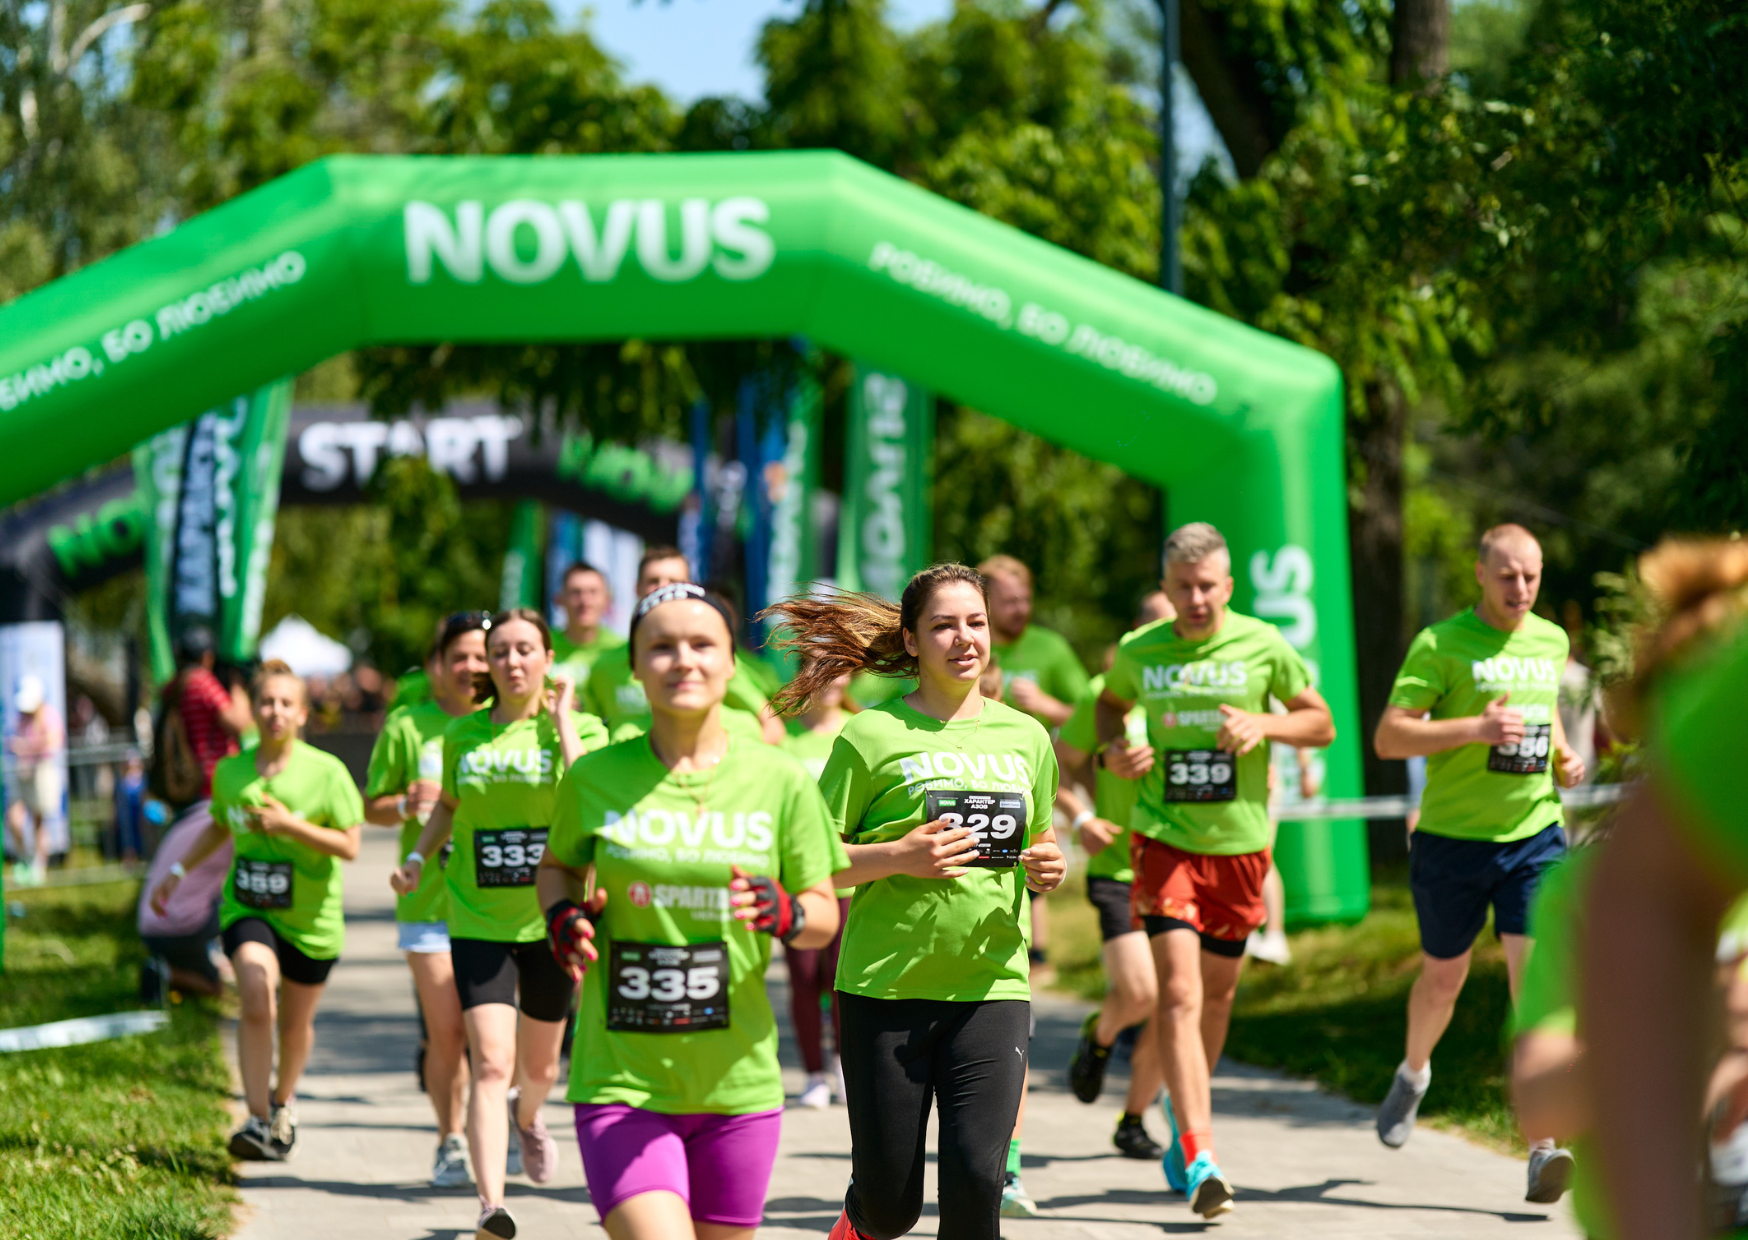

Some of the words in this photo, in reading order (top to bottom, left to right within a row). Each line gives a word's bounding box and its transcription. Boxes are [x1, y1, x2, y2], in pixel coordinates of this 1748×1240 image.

[404, 197, 775, 283] NOVUS
[101, 319, 153, 363] БО
[156, 250, 306, 340] ЛЮБИМО
[1017, 302, 1070, 346] БО
[1065, 324, 1217, 405] ЛЮБИМО
[1142, 661, 1248, 691] NOVUS
[1474, 656, 1557, 683] NOVUS
[899, 751, 1030, 786] NOVUS
[1169, 763, 1232, 785] 339
[908, 777, 968, 796] РОБИМО,
[971, 779, 988, 790] БО
[603, 808, 774, 852] NOVUS
[481, 843, 546, 868] 333
[618, 966, 720, 1002] 335
